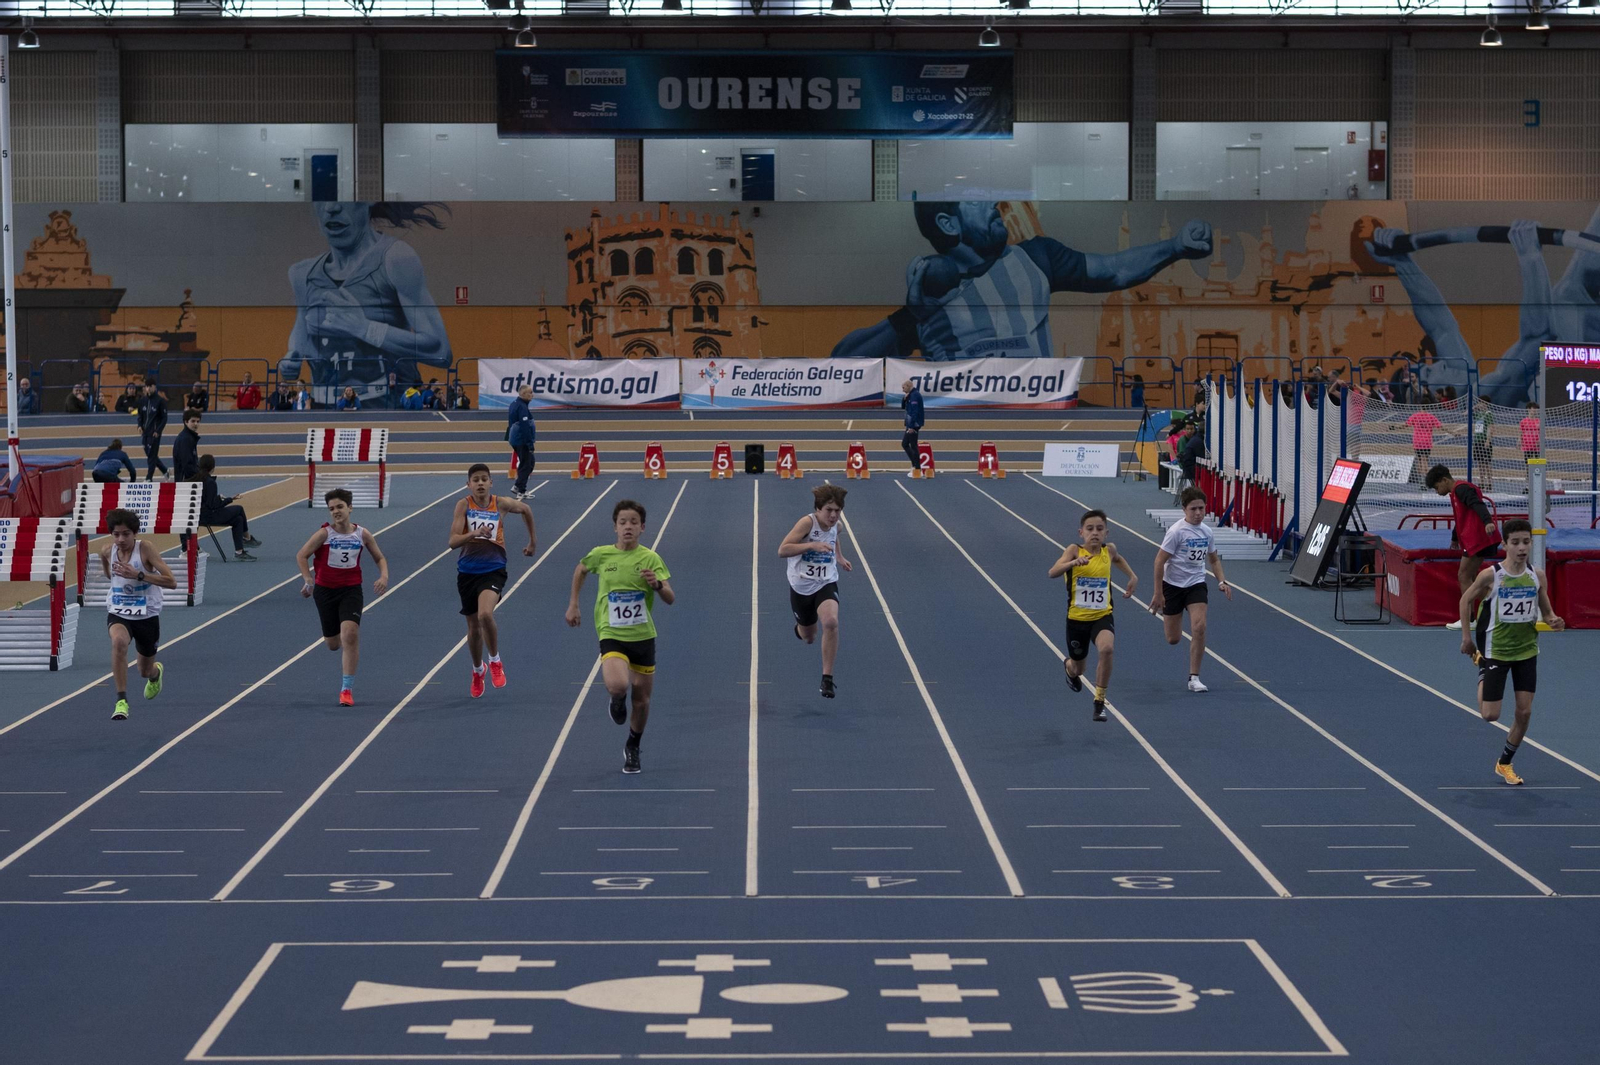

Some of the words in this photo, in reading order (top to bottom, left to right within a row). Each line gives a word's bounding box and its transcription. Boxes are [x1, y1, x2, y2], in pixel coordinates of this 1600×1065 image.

[657, 76, 863, 110] OURENSE
[1523, 100, 1541, 127] 3
[2, 150, 8, 158] 5
[4, 224, 10, 232] 4
[6, 298, 12, 306] 3
[330, 351, 355, 371] 17
[1545, 346, 1564, 361] PESO
[1565, 347, 1573, 364] (3
[1574, 347, 1588, 364] KG)
[8, 372, 13, 380] 2
[732, 366, 804, 381] Federación
[807, 366, 864, 383] Galega
[500, 370, 659, 400] atletismo.gal
[732, 386, 746, 396] de
[751, 382, 822, 397] Atletismo
[583, 453, 594, 470] 7
[649, 453, 661, 470] 6
[717, 453, 728, 470] 5
[780, 453, 792, 470] 4
[851, 453, 863, 469] 3
[919, 453, 930, 469] 2
[985, 453, 994, 470] 1
[1060, 462, 1100, 470] DEPUTACIÓN
[340, 552, 350, 563] 3
[1188, 549, 1207, 561] 326
[806, 565, 827, 577] 311
[1081, 590, 1104, 603] 113
[614, 604, 643, 620] 162
[1503, 601, 1533, 616] 247
[63, 879, 130, 895] 7
[328, 878, 395, 894] 6
[591, 875, 655, 891] 5
[851, 875, 918, 889] 4
[1111, 874, 1175, 890] 3
[1363, 873, 1433, 889] 2
